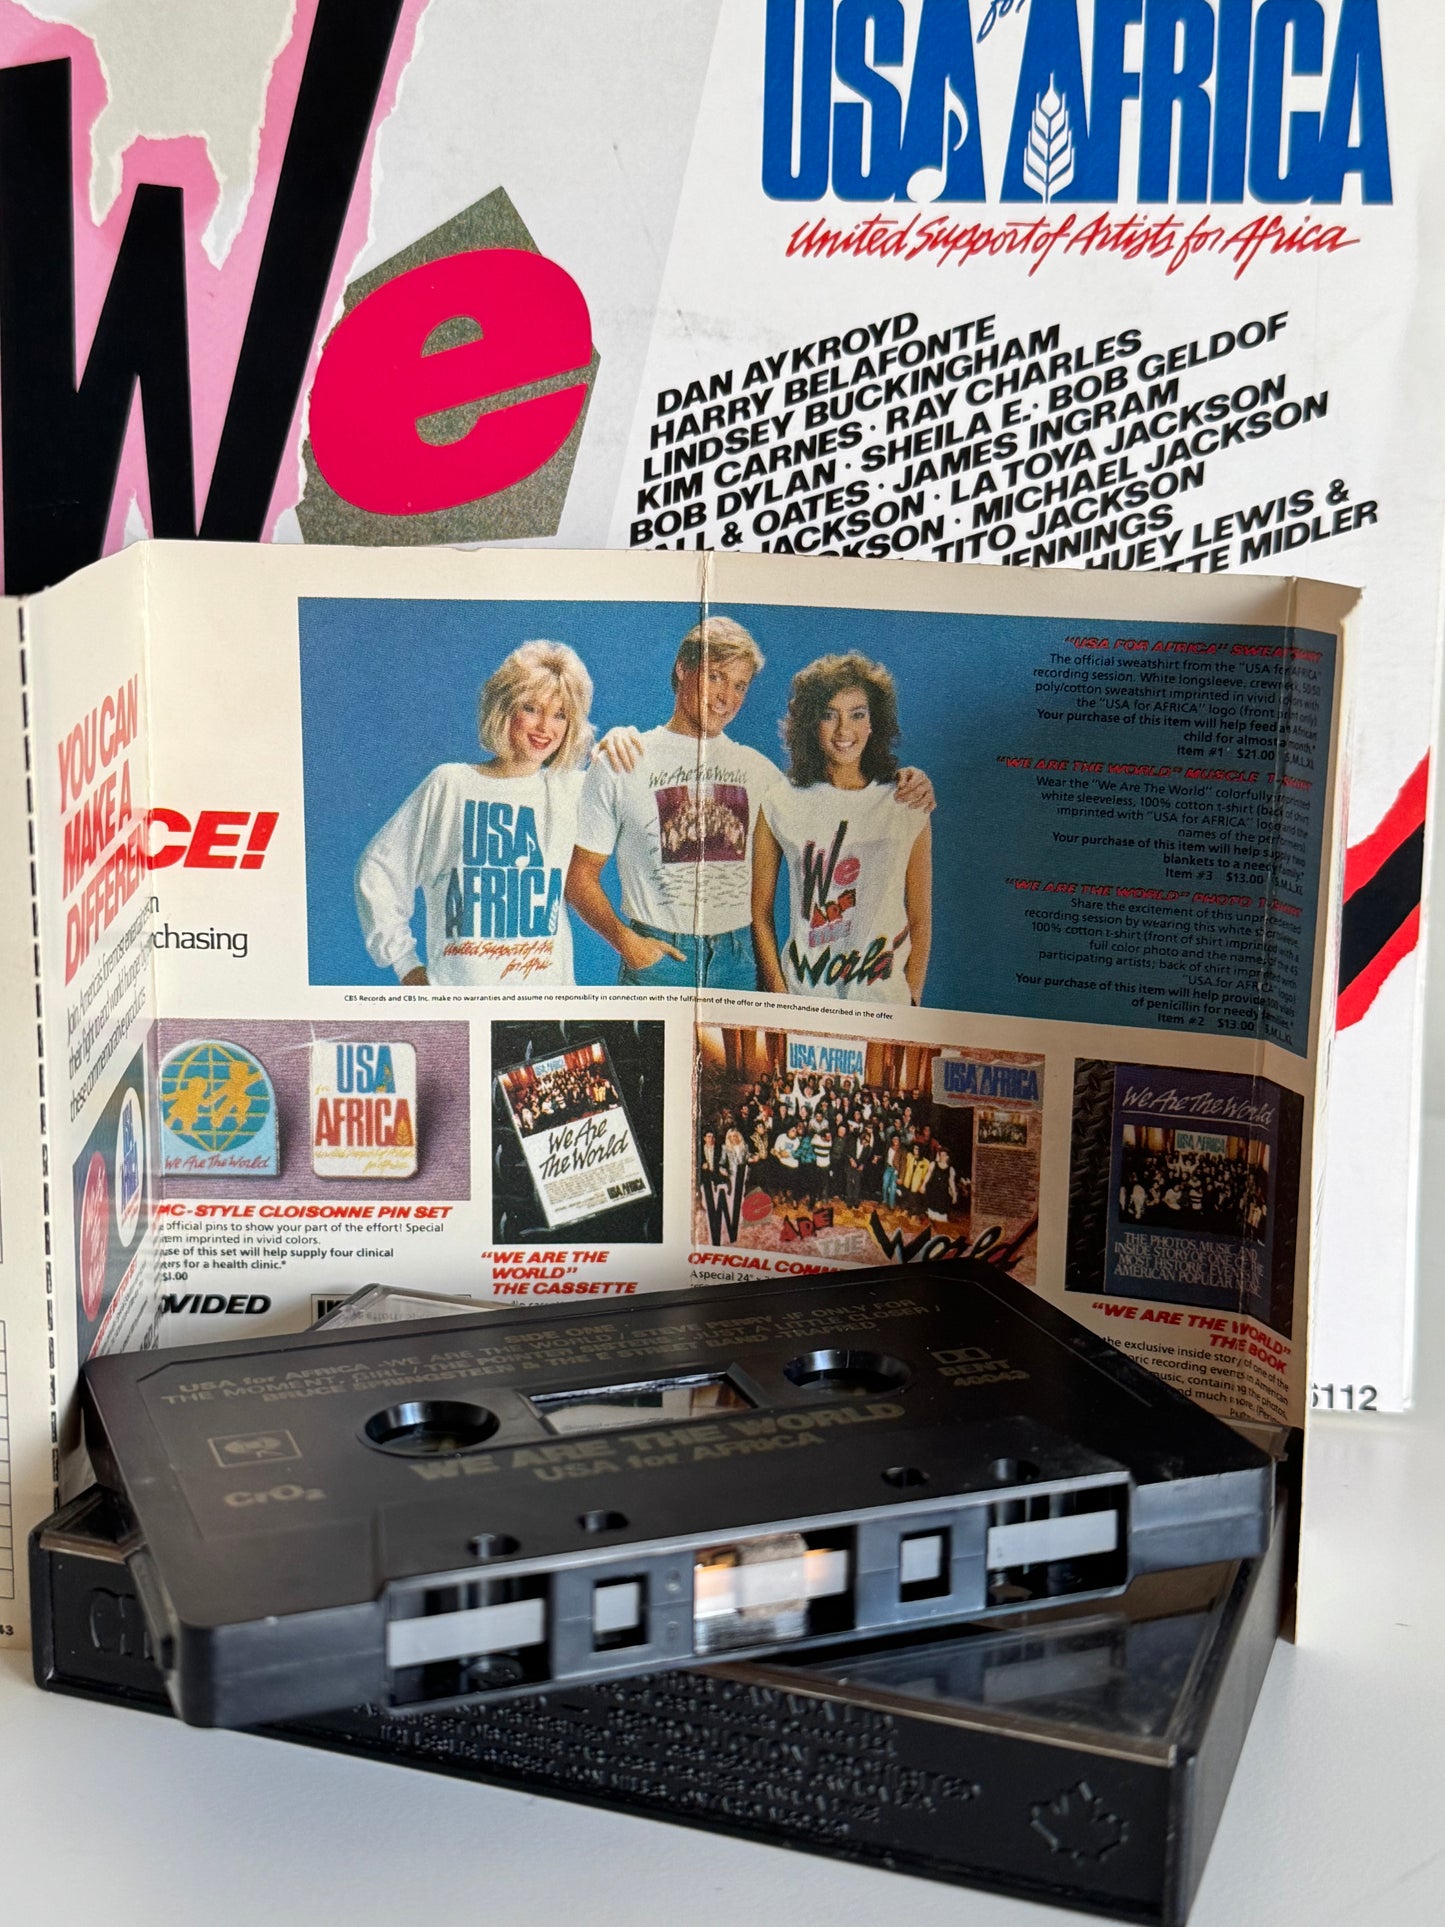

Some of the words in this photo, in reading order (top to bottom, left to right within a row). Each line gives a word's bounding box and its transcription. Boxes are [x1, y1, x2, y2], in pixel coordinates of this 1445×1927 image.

[762, 0, 986, 203] USA
[999, 0, 1394, 205] AFRICA
[785, 213, 922, 260] United
[904, 214, 1051, 268] Support
[1028, 213, 1070, 277] of
[1062, 211, 1184, 260] Artists
[1165, 213, 1225, 276] for
[1218, 214, 1360, 280] Africa
[0, 0, 592, 596] We
[650, 387, 774, 450] HARRY
[784, 313, 996, 406] BELAFONTE
[657, 369, 733, 418] DAN
[742, 311, 919, 390] AYKROYD
[637, 471, 704, 515] KIM
[714, 421, 863, 489] CARNES
[886, 388, 960, 435] RAY
[965, 328, 1142, 407] CHARLES
[643, 411, 794, 484] LINDSEY
[804, 323, 1060, 432] BUCKINGHAM
[630, 502, 707, 548] BOB
[716, 459, 837, 520] DYLAN
[861, 412, 993, 472] SHEILA
[1001, 398, 1031, 430] E.
[1048, 366, 1129, 415] BOB
[1137, 311, 1289, 383] GELDOF
[720, 521, 744, 548] &
[752, 480, 871, 537] OATES
[892, 432, 1018, 494] JAMES
[1028, 377, 1180, 450] INGRAM
[761, 491, 925, 554] JACKSON
[951, 470, 999, 505] LA
[1001, 438, 1096, 489] TOYA
[1103, 374, 1286, 457] JACKSON
[972, 457, 1138, 529] MICHAEL
[1144, 391, 1328, 474] JACKSON
[931, 524, 1017, 562] TITO
[1025, 461, 1205, 540] JACKSON
[1085, 529, 1184, 571] HUEY
[1192, 488, 1314, 550] LEWIS
[1325, 478, 1349, 508] &
[1240, 500, 1379, 565] MIDLER
[1050, 653, 1071, 665] The
[1074, 655, 1115, 667] official
[1117, 658, 1180, 671] sweatshirt
[1183, 660, 1212, 673] from
[1215, 661, 1236, 673] the
[1114, 639, 1148, 652] FOR
[1033, 668, 1089, 682] recording
[1140, 673, 1176, 684] White
[58, 707, 97, 815] YOU
[99, 673, 138, 768] CAN
[1033, 758, 1069, 771] ARE
[1072, 761, 1103, 773] THE
[1237, 750, 1275, 760] $21.00
[63, 770, 117, 901] MAKE
[118, 759, 132, 832] A
[463, 799, 544, 868] USA
[445, 867, 562, 938] AFRICA
[1217, 1018, 1255, 1031] $13.00
[336, 1044, 396, 1094] USA
[314, 1098, 414, 1147] AFRICA
[549, 1126, 573, 1154] We
[574, 1118, 607, 1146] Are
[165, 1155, 182, 1170] We
[539, 1153, 571, 1180] The
[573, 1130, 628, 1171] World
[167, 1221, 202, 1230] official
[206, 1222, 228, 1232] pins
[231, 1223, 242, 1231] to
[246, 1222, 274, 1231] show
[277, 1224, 302, 1233] your
[304, 1223, 327, 1233] part
[331, 1223, 342, 1232] of
[345, 1223, 363, 1232] the
[366, 1223, 402, 1232] effort!
[406, 1223, 444, 1234] Special
[259, 1205, 374, 1218] CLOISONNE
[378, 1206, 411, 1218] PIN
[414, 1206, 453, 1219] SET
[212, 1260, 248, 1269] health
[221, 1248, 236, 1256] set
[240, 1248, 260, 1256] will
[263, 1248, 287, 1258] help
[290, 1249, 327, 1260] supply
[330, 1248, 354, 1257] four
[356, 1248, 394, 1257] clinical
[527, 1251, 568, 1263] ARE
[572, 1251, 609, 1263] THE
[688, 1252, 771, 1271] OFFICIAL
[699, 1271, 734, 1281] special
[493, 1283, 530, 1295] THE
[532, 1282, 638, 1294] CASSETTE
[1139, 1310, 1184, 1326] ARE
[1187, 1314, 1228, 1331] THE
[1152, 1358, 1207, 1374] recording
[1209, 1334, 1246, 1352] THE
[1247, 1344, 1287, 1374] BOOK
[1312, 1382, 1378, 1412] 112
[409, 1453, 501, 1482] WE
[511, 1438, 616, 1468] ARE
[619, 1425, 727, 1450] THE
[728, 1402, 906, 1437] WORLD
[692, 1431, 826, 1461] AFRICA
